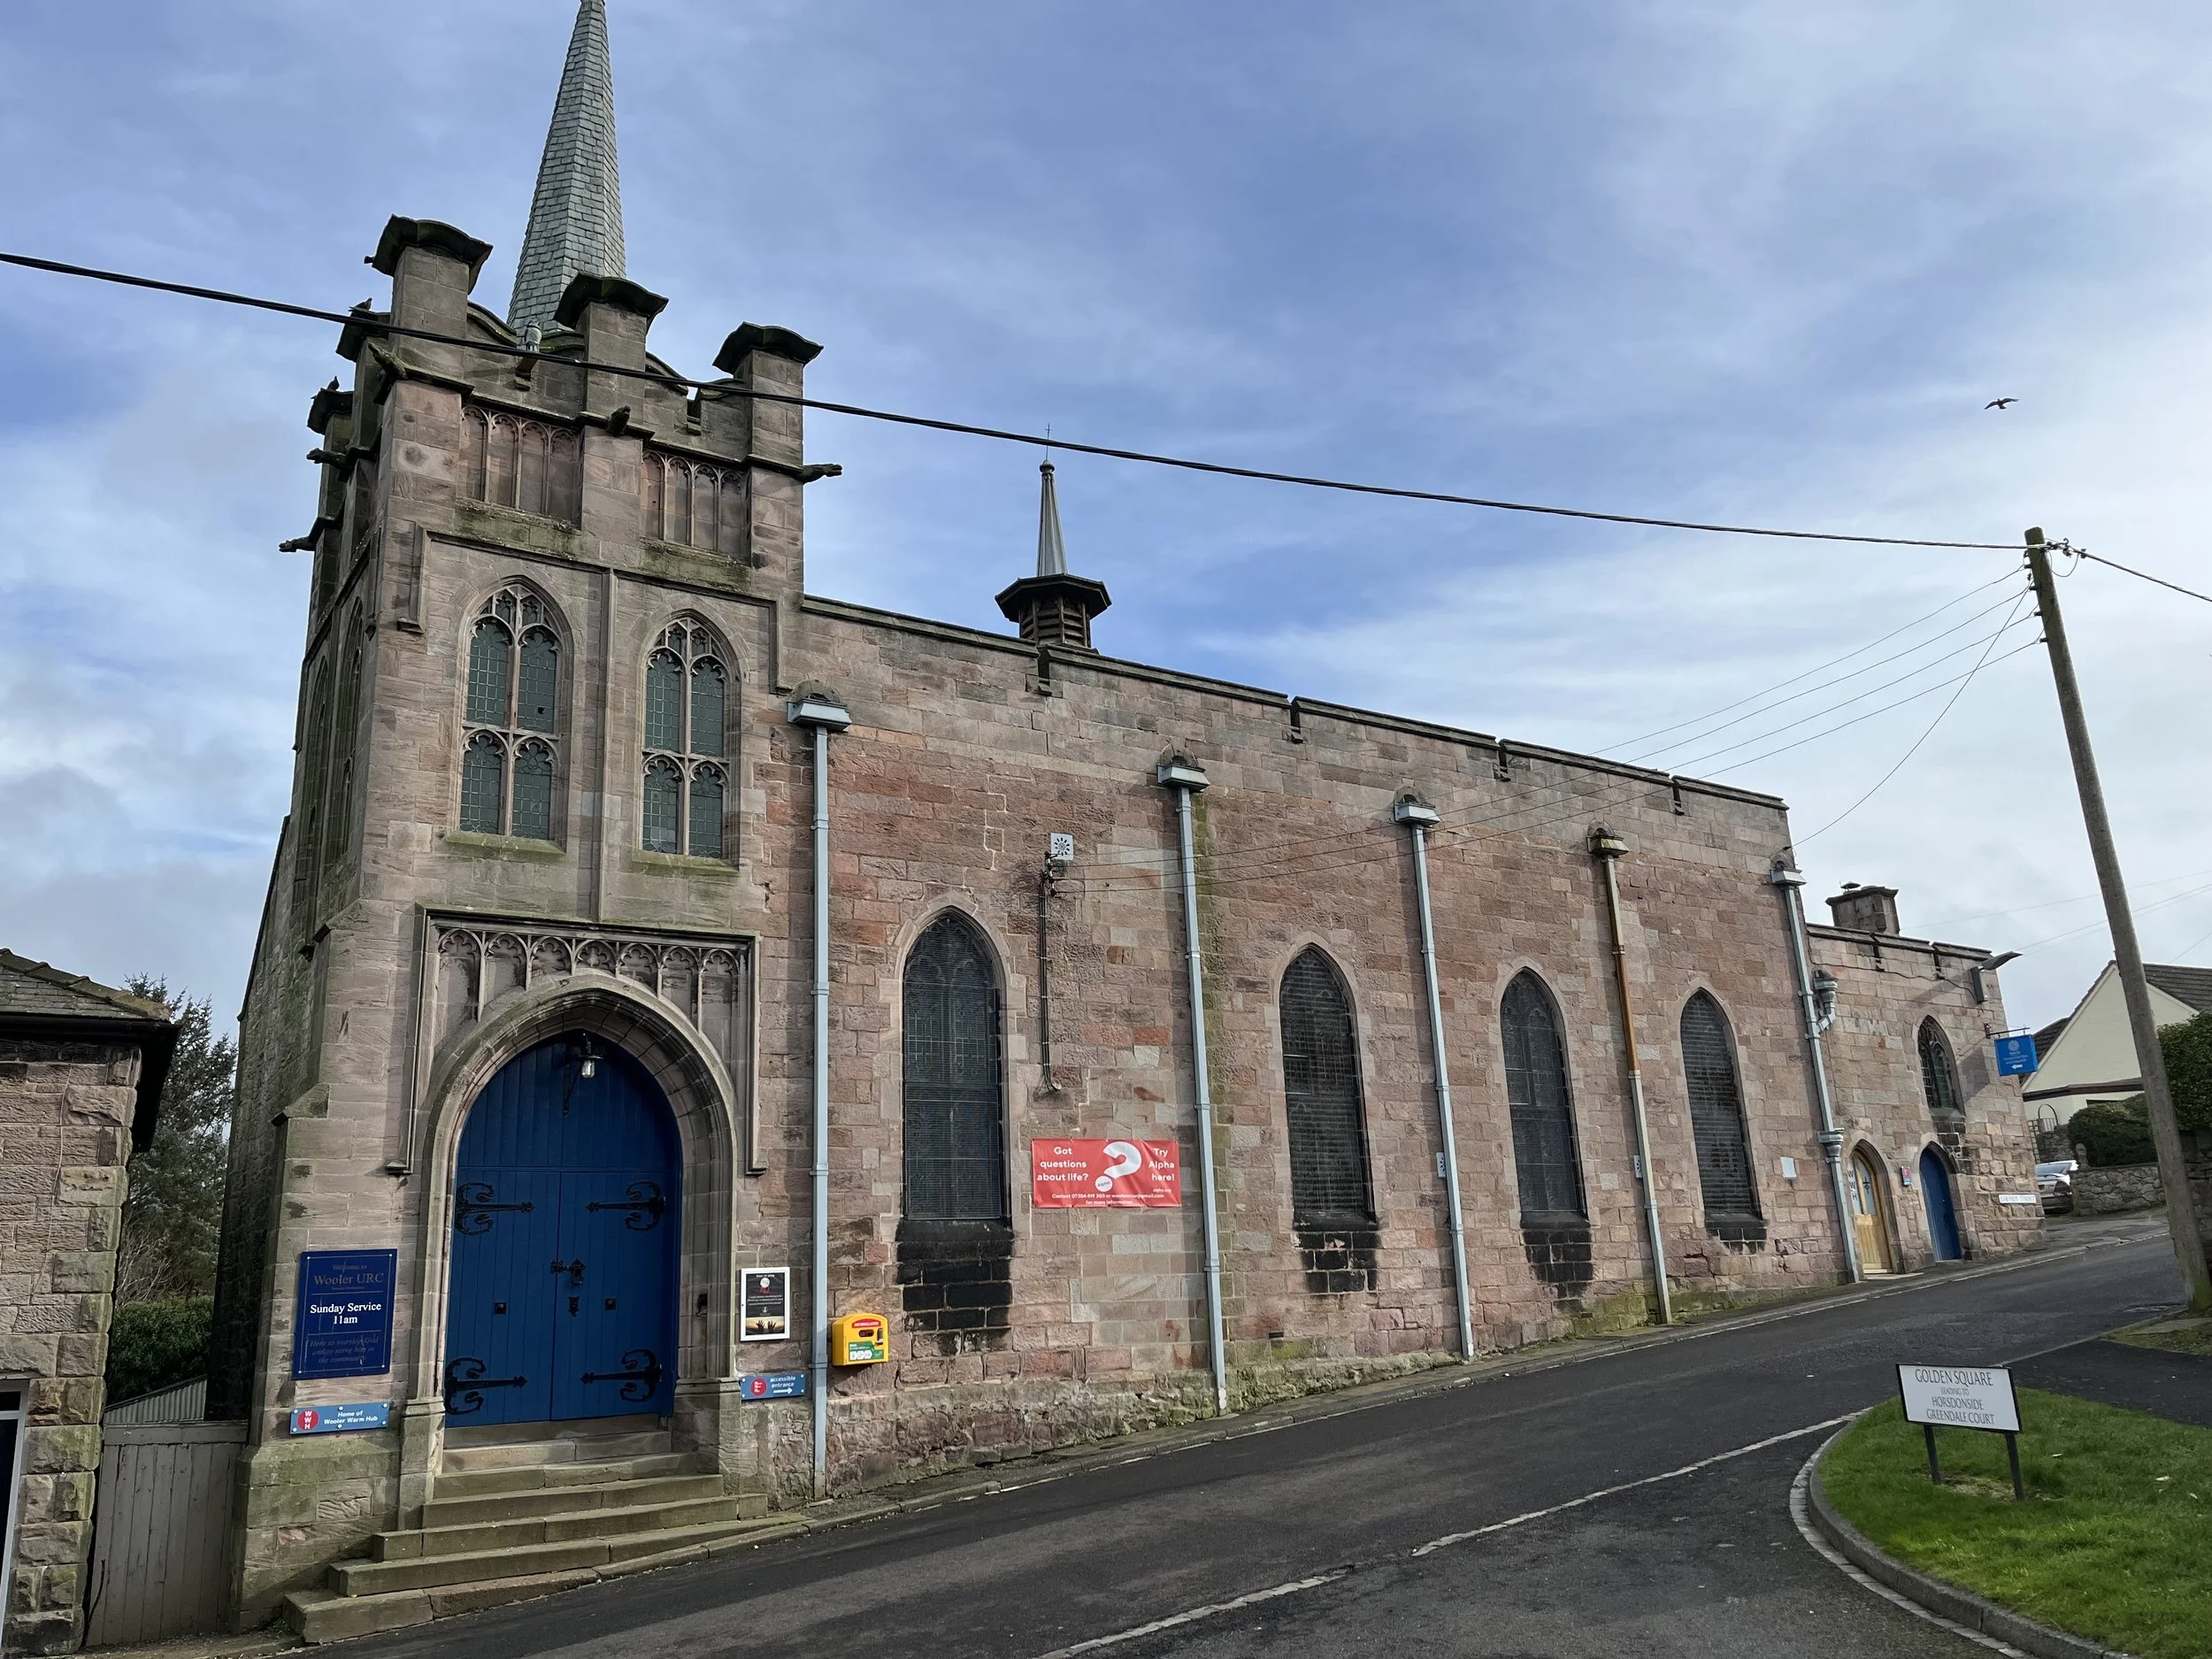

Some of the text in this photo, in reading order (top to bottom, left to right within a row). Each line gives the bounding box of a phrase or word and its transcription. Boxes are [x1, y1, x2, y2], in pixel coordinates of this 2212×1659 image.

[1154, 1148, 1168, 1157] Try
[1040, 1160, 1087, 1170] questions
[1148, 1161, 1175, 1170] Alpha
[1037, 1172, 1089, 1181] about life?
[313, 1272, 384, 1285] Wooler URC
[310, 1302, 382, 1315] Sunday Service
[334, 1315, 358, 1325] 11am
[1915, 1369, 1994, 1387] GOLDEN SQUARE
[1940, 1386, 1962, 1395] LEADING
[1932, 1396, 1985, 1410] HORSDONSIDE
[1926, 1409, 1995, 1425] GREENDALE COURT
